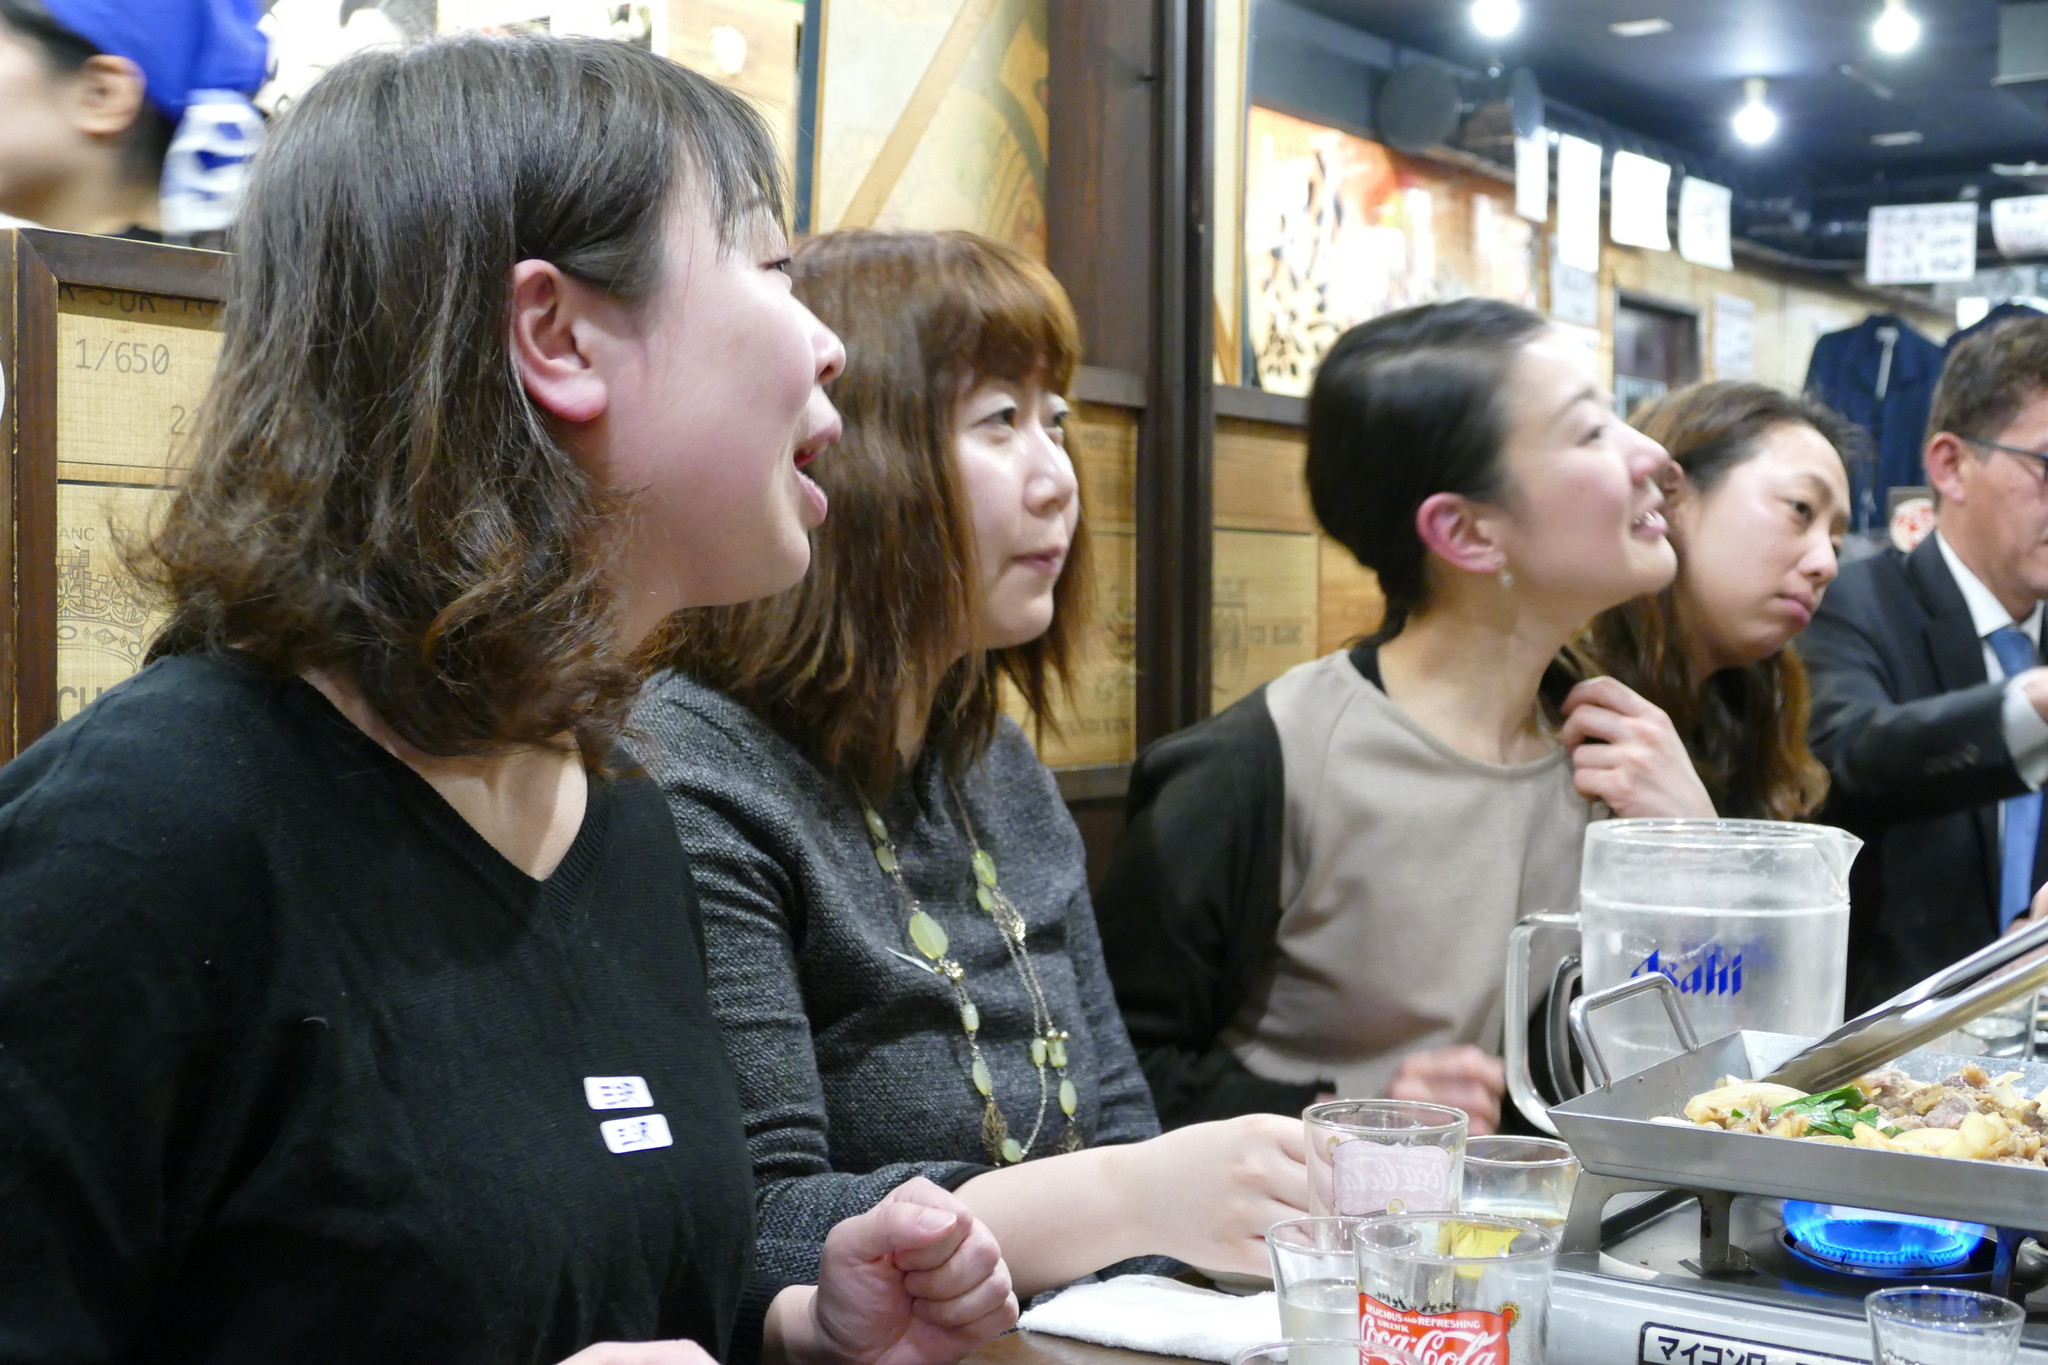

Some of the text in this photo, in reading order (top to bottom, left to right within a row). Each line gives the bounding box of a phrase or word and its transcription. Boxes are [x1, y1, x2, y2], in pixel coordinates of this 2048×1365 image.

[76, 338, 170, 375] 1/650
[1631, 949, 1742, 996] Asahi
[1365, 1303, 1480, 1329] DELICIOUS AND REFRESHING
[1377, 1320, 1409, 1333] DRINK
